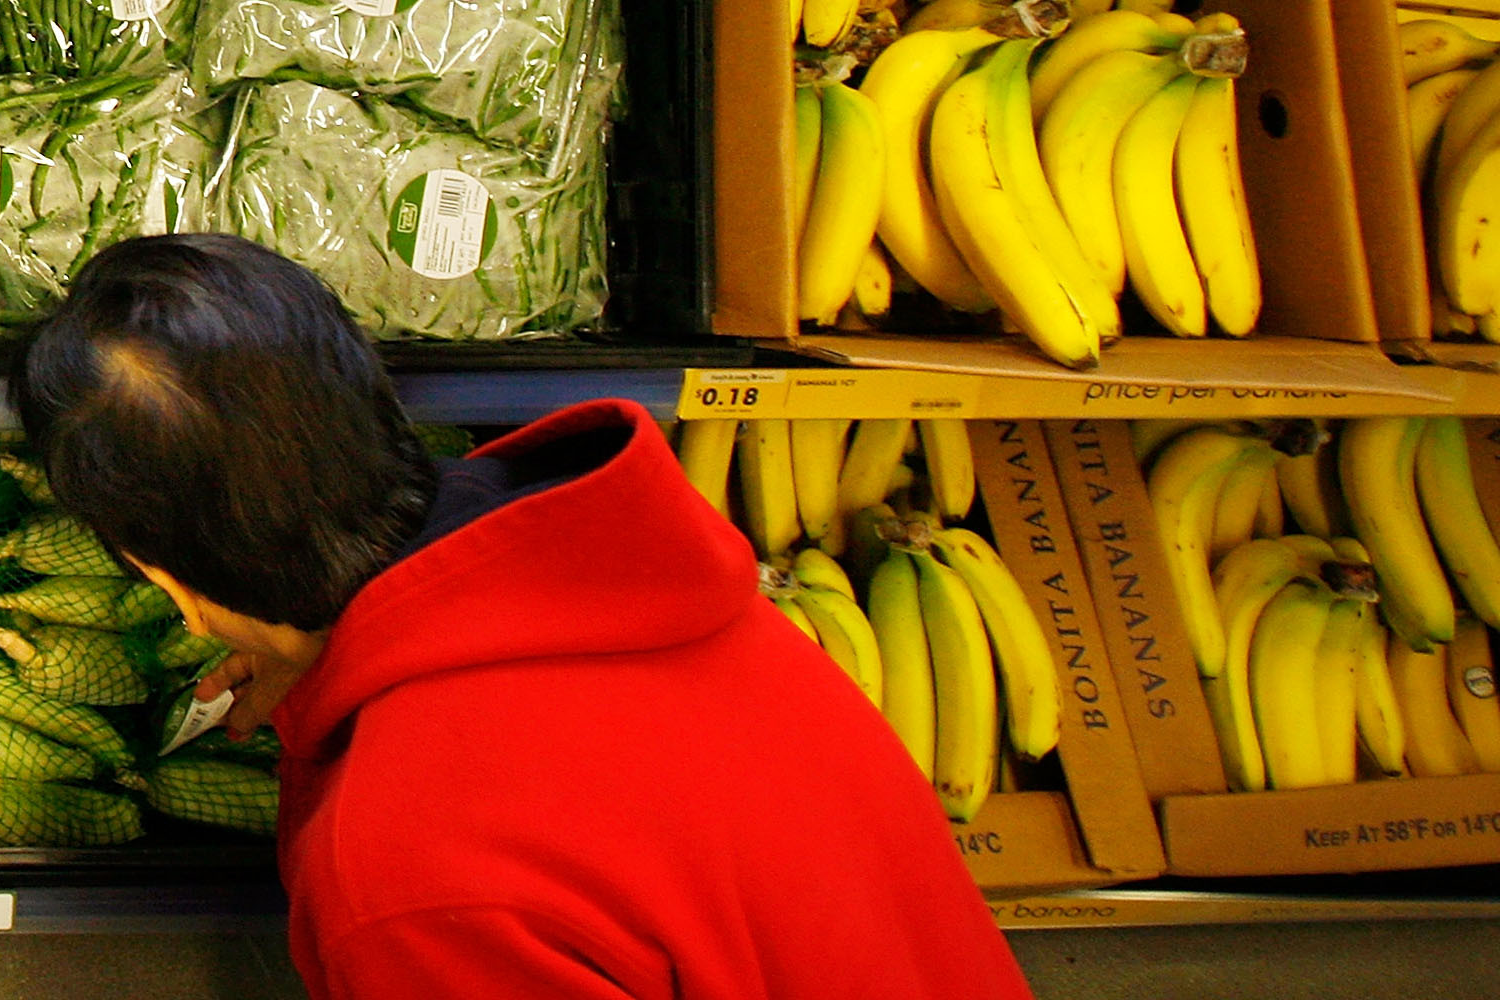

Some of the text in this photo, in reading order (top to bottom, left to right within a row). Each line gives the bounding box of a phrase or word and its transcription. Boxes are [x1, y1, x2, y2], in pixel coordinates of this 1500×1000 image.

[695, 387, 759, 406] $0.18
[1041, 572, 1110, 731] BONITA
[1099, 520, 1177, 720] BANANAS
[1014, 904, 1117, 918] banana
